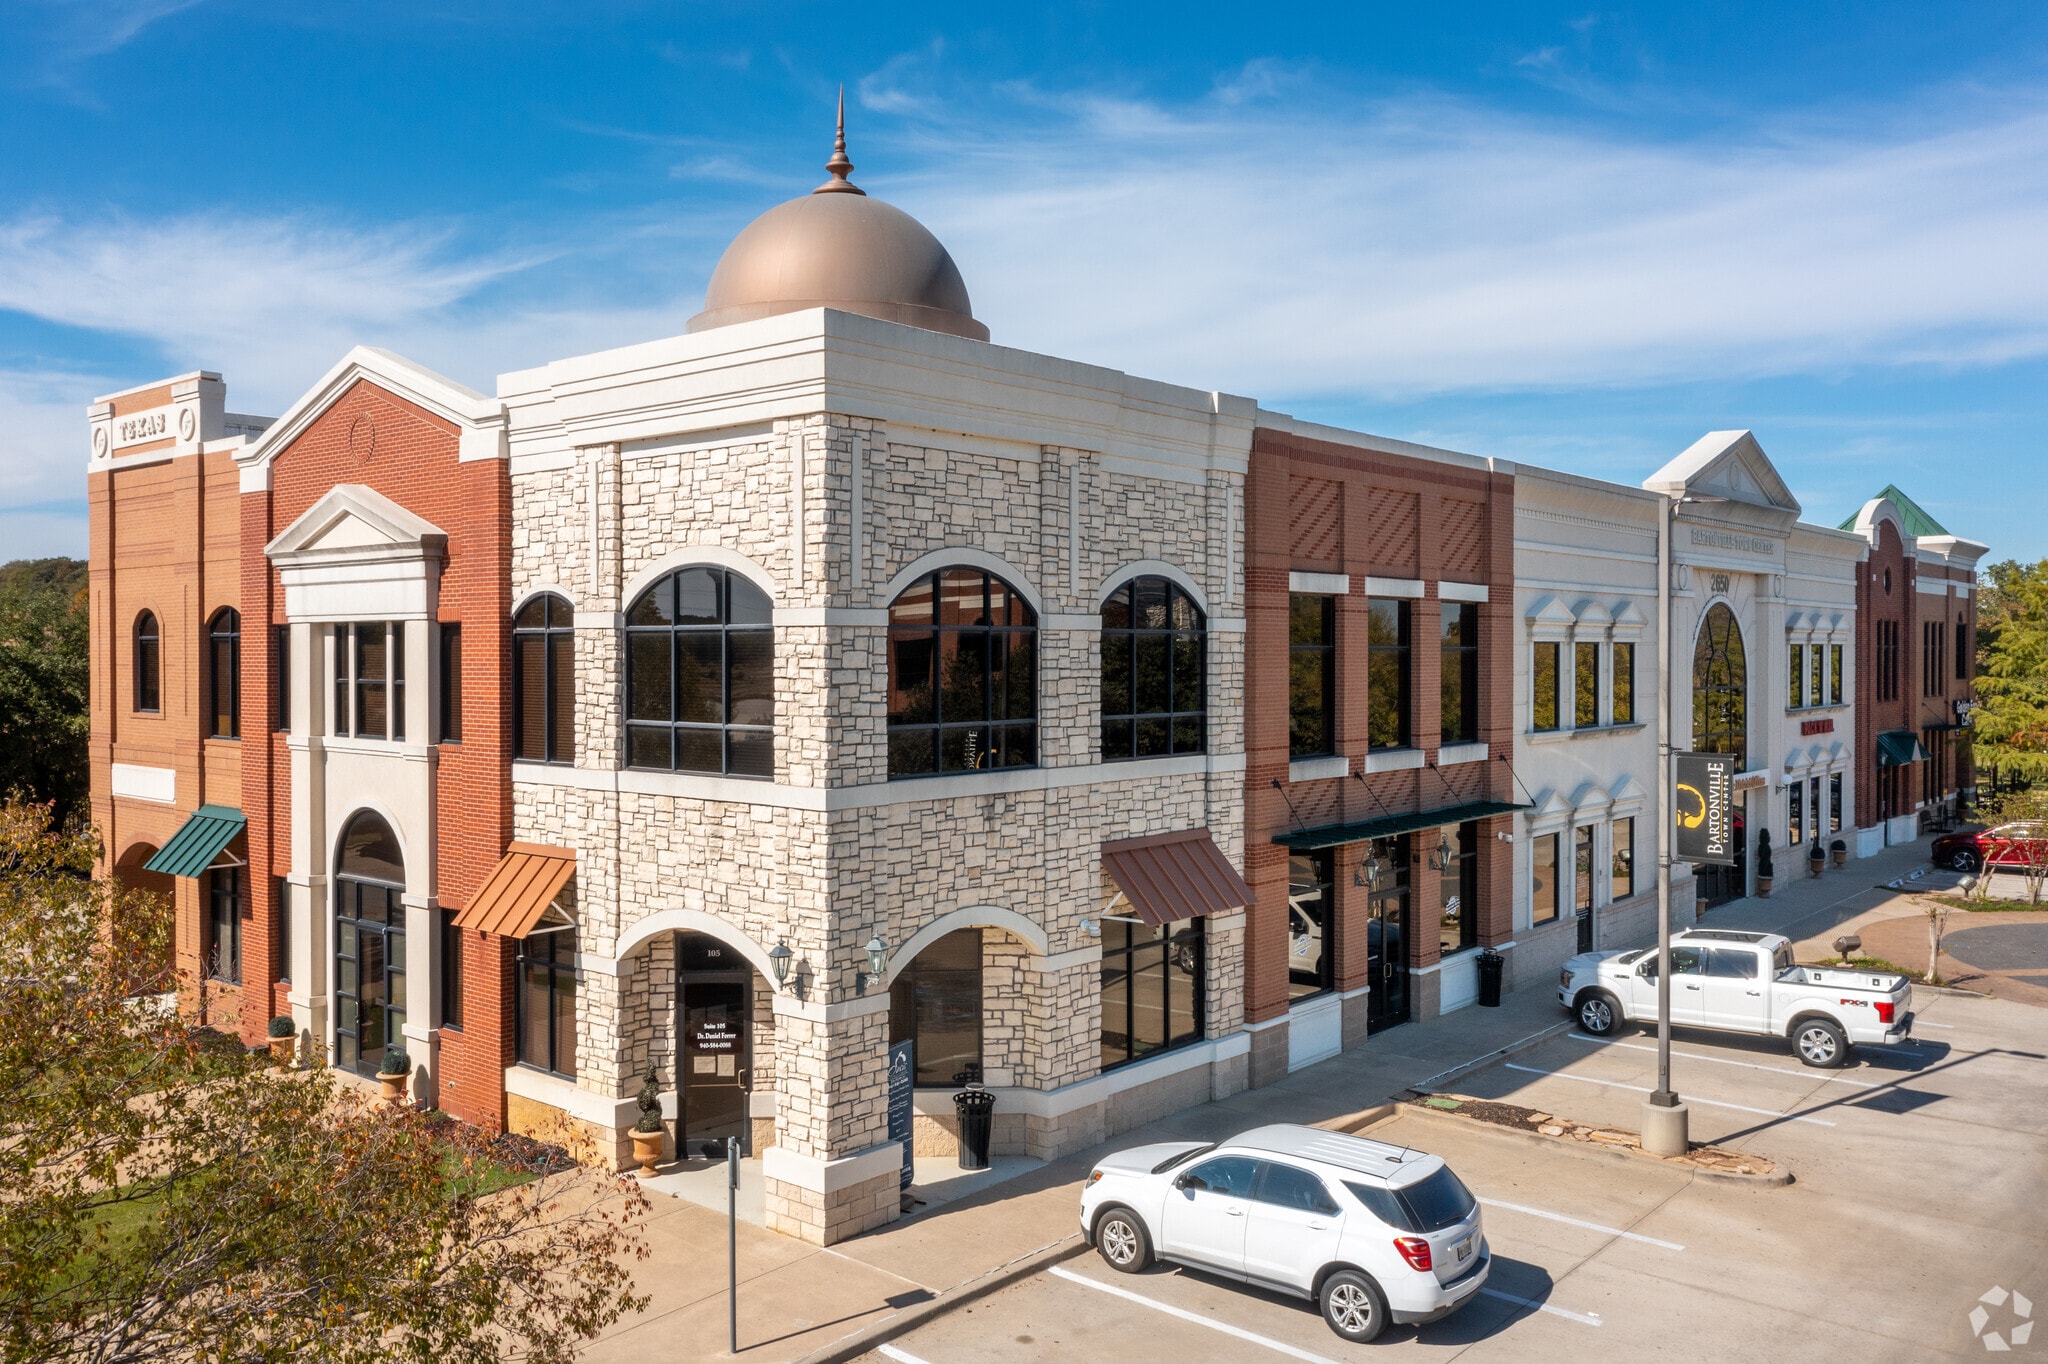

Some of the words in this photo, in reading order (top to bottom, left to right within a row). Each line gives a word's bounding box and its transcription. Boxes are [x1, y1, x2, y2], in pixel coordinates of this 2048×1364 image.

[119, 413, 166, 442] TEXAS
[1710, 573, 1730, 593] 2650
[1707, 762, 1724, 855] BARTONVILLE
[707, 949, 721, 957] 105
[1840, 998, 1868, 1007] FX4
